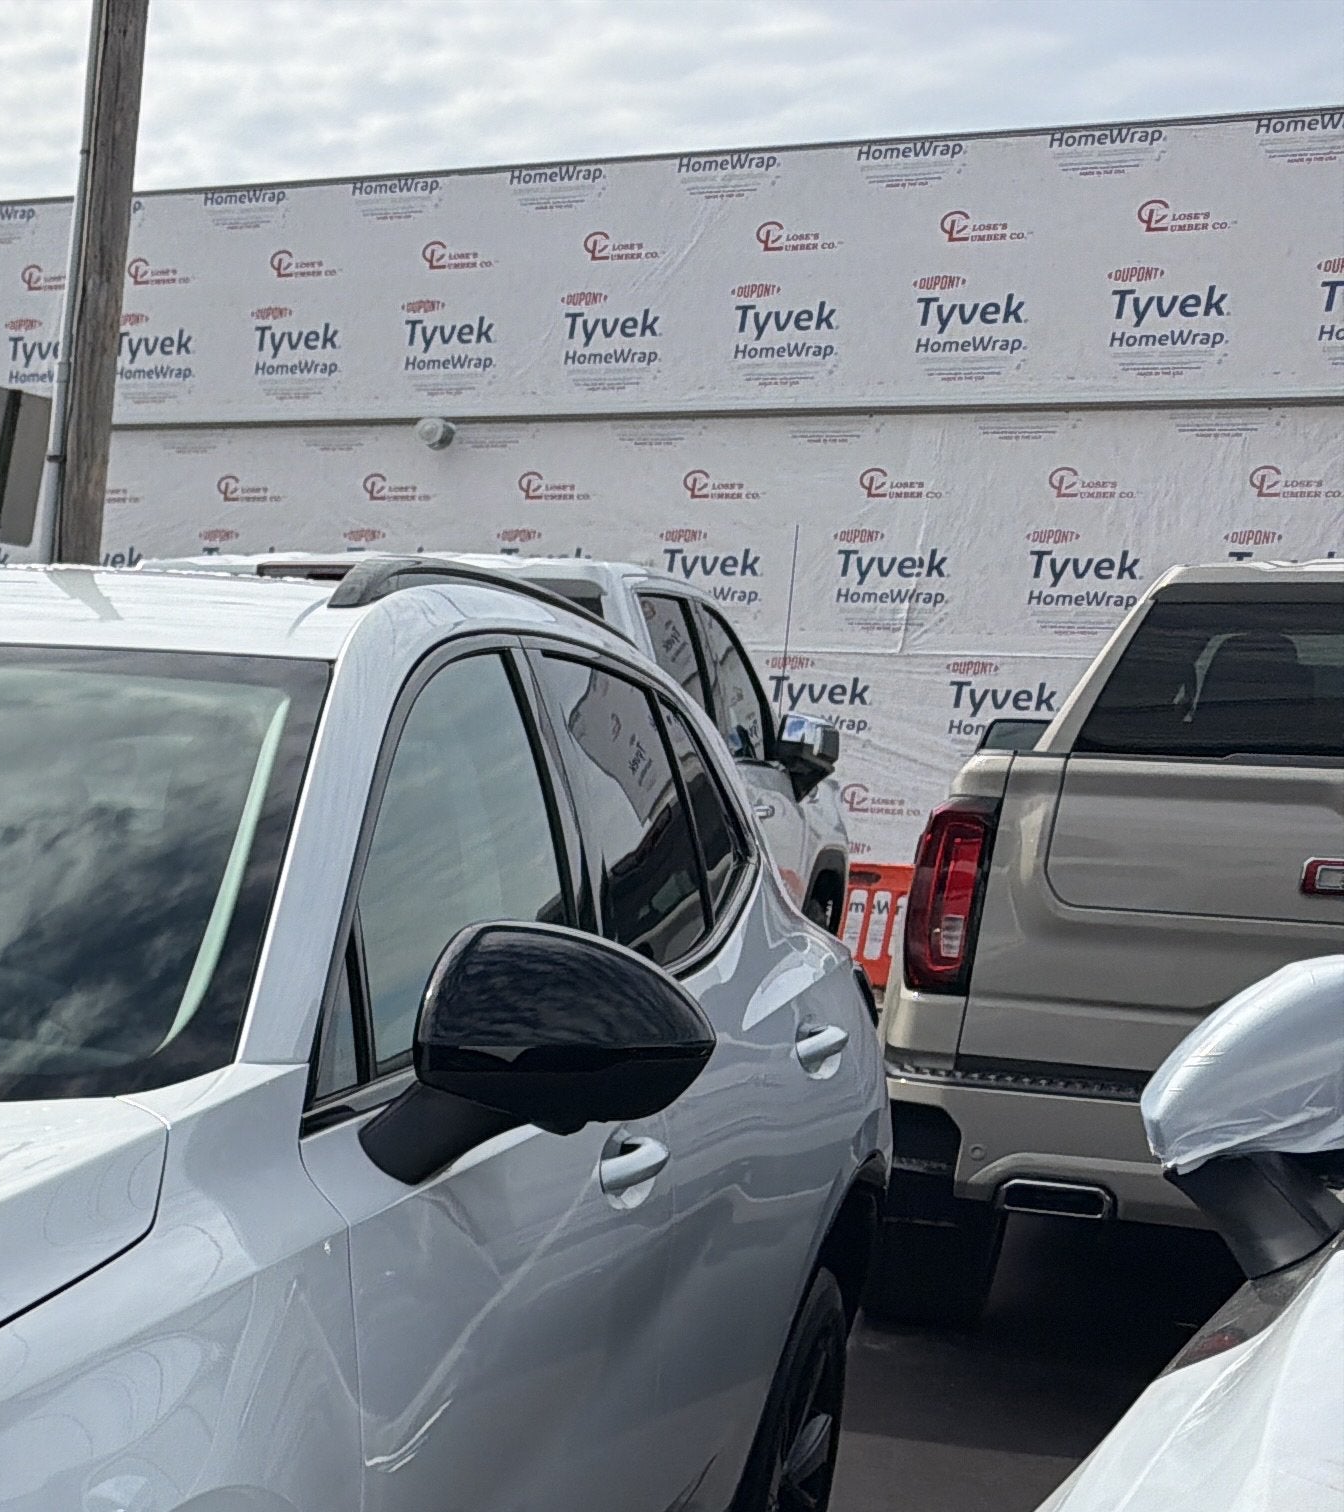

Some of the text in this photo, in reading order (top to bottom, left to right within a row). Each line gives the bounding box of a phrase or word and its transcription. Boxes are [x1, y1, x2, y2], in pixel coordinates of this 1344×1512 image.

[1255, 113, 1344, 134] HomeW
[735, 301, 836, 341] Tyvek
[917, 293, 1024, 334] Tyvek
[1112, 285, 1228, 328] Tyvek
[255, 323, 337, 358] Tyvek
[404, 317, 495, 353] Tyvek
[564, 309, 659, 347] Tyvek
[117, 329, 191, 364] Tyvek
[663, 549, 760, 579] Tyvek
[838, 549, 948, 585] Tyvek
[1030, 550, 1140, 587] Tyvek
[769, 675, 869, 709] Tyvek
[949, 681, 1056, 716] Tyvek
